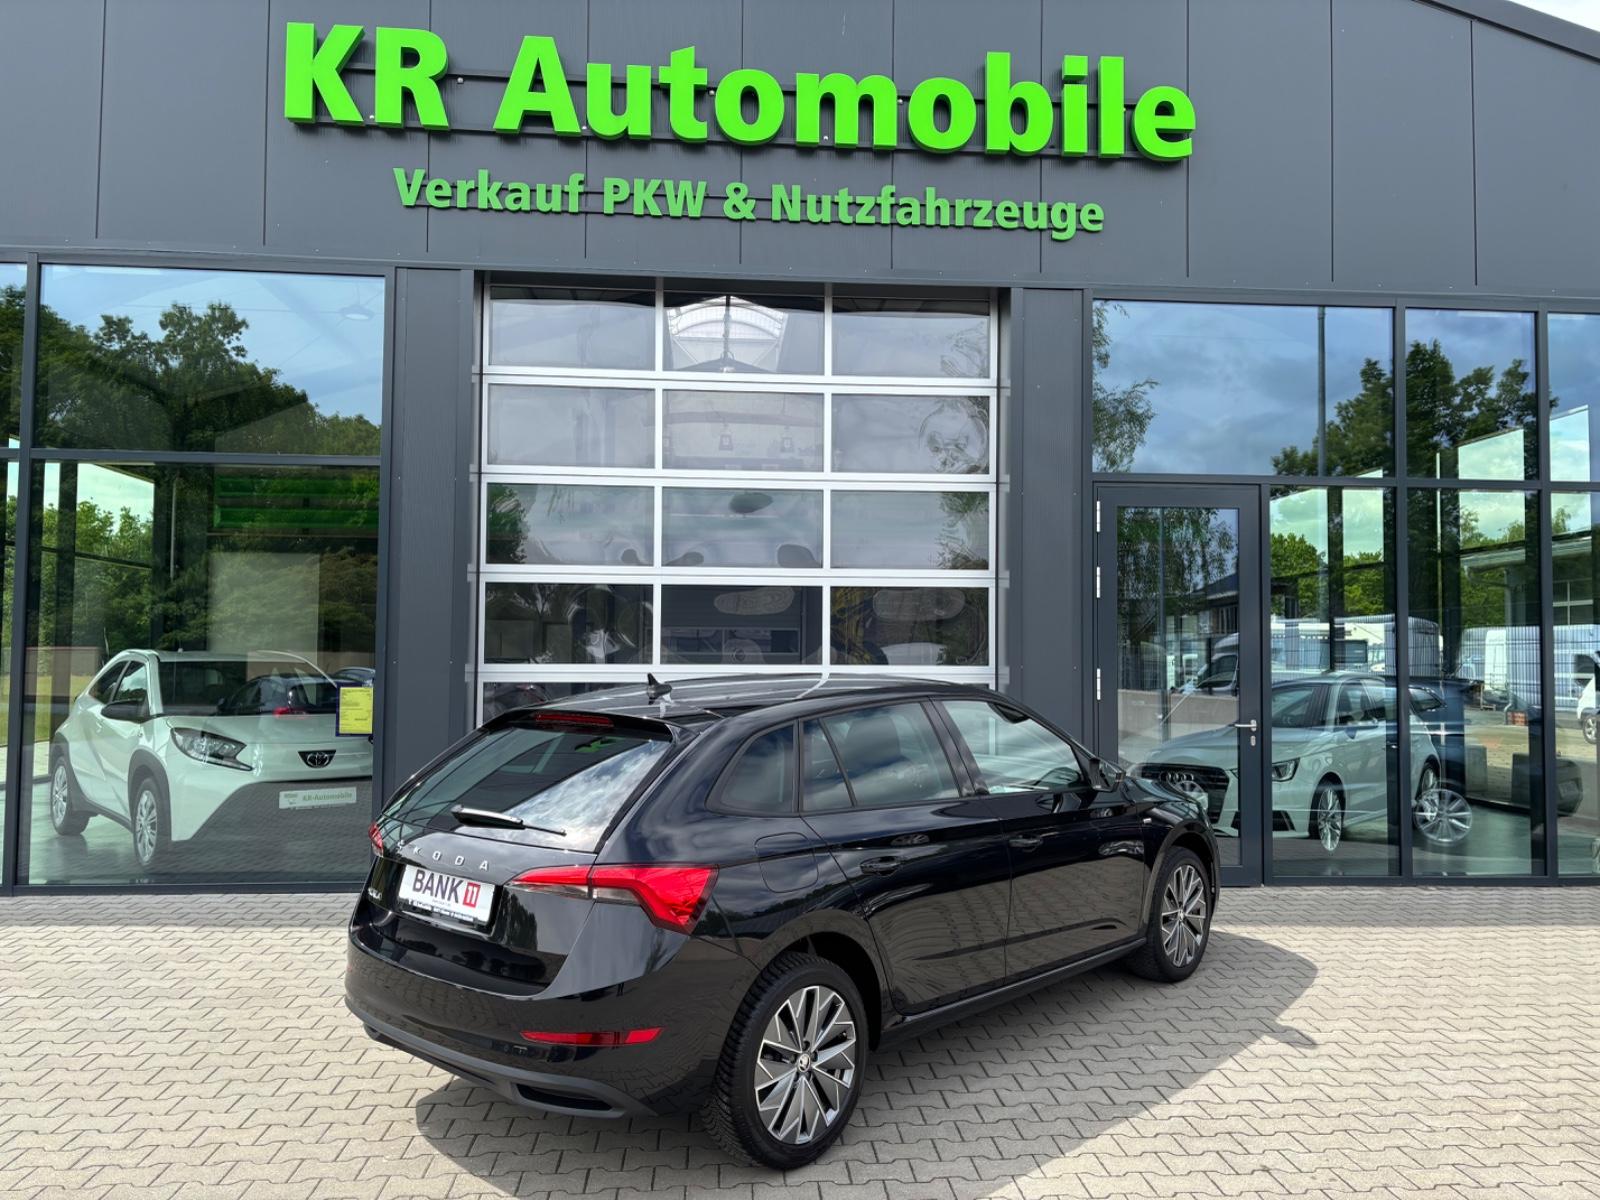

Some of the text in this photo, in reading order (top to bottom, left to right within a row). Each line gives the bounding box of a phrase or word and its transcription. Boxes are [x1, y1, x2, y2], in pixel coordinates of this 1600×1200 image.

[284, 22, 1197, 159] KR Automobile
[395, 169, 1105, 242] Verkauf PKW & Nutzfahrzeuge
[412, 868, 463, 904] BANK
